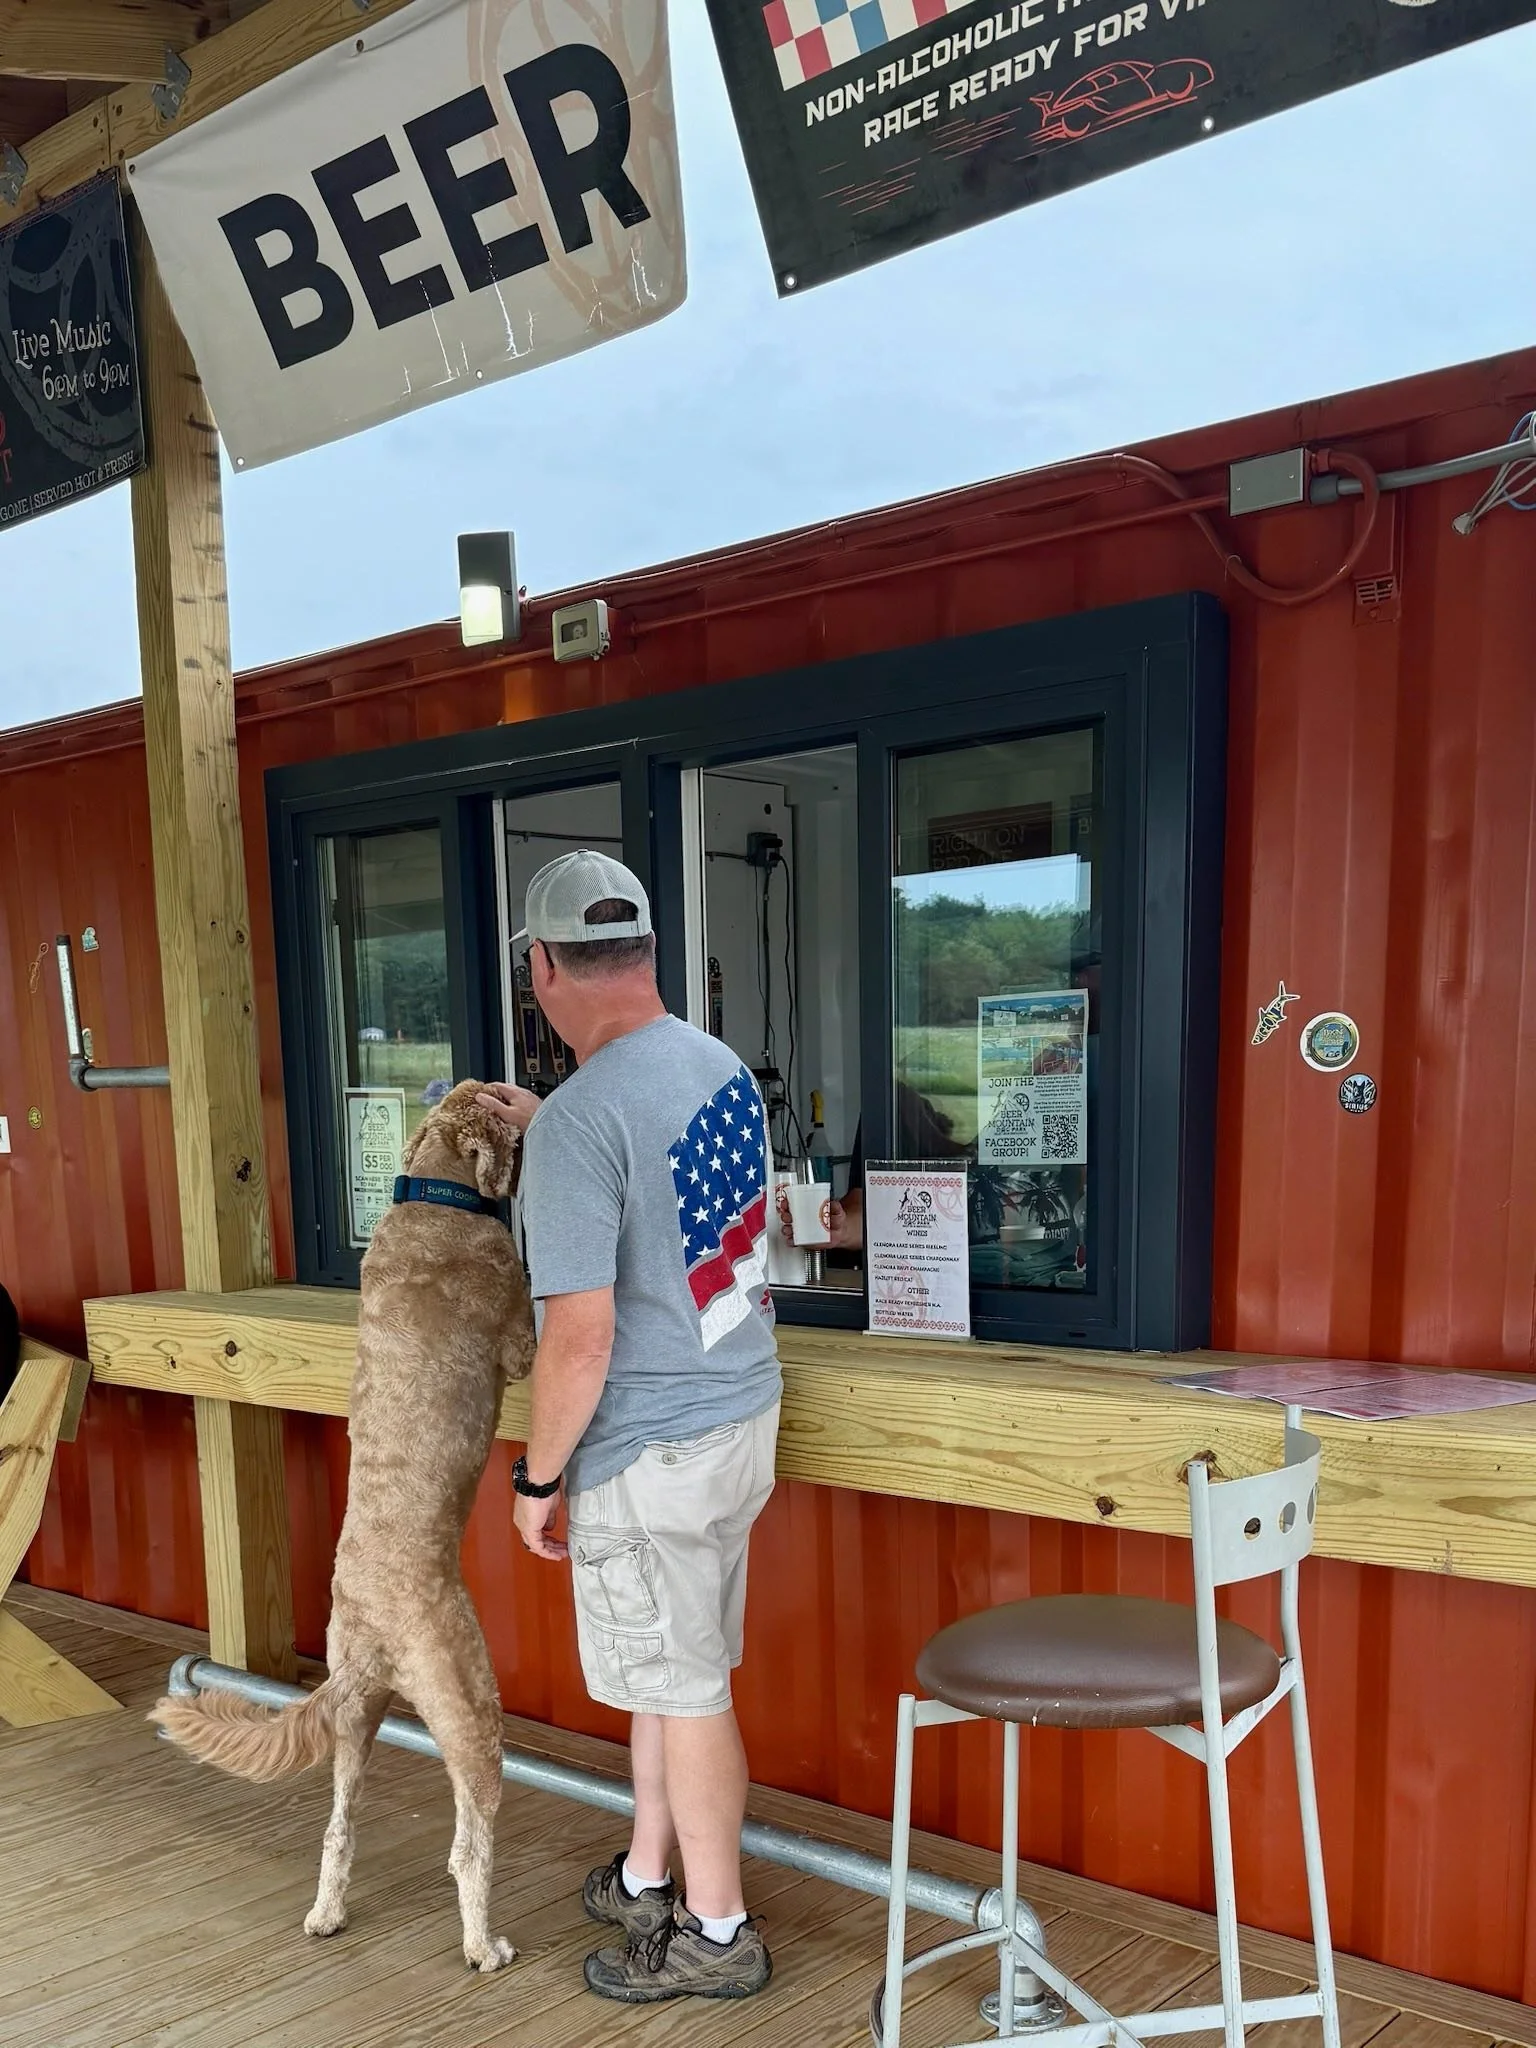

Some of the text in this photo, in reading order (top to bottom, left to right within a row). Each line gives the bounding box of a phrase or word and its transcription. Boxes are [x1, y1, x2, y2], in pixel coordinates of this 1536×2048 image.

[805, 1, 1046, 127] NON-ALCOHOLIC
[863, 2, 1150, 148] RACE READY FOR
[217, 43, 651, 370] BEER
[12, 316, 112, 370] Live Music
[83, 369, 96, 389] to
[0, 496, 29, 522] GONE
[33, 479, 73, 509] SERVED
[74, 470, 97, 491] HOT
[104, 450, 135, 477] FRESH
[988, 1078, 1012, 1089] JOIN
[1013, 1077, 1034, 1087] THE
[1000, 1110, 1023, 1119] BEER
[988, 1118, 1035, 1128] MOUNTAIN
[985, 1137, 1037, 1148] FACEBOOK
[364, 1153, 378, 1169] $5
[379, 1154, 391, 1162] PER
[426, 1185, 453, 1197] SUPER
[907, 1205, 926, 1213] BEER
[897, 1213, 937, 1221] MOUNTAIN
[906, 1229, 928, 1237] WINES
[907, 1286, 930, 1295] OTHER
